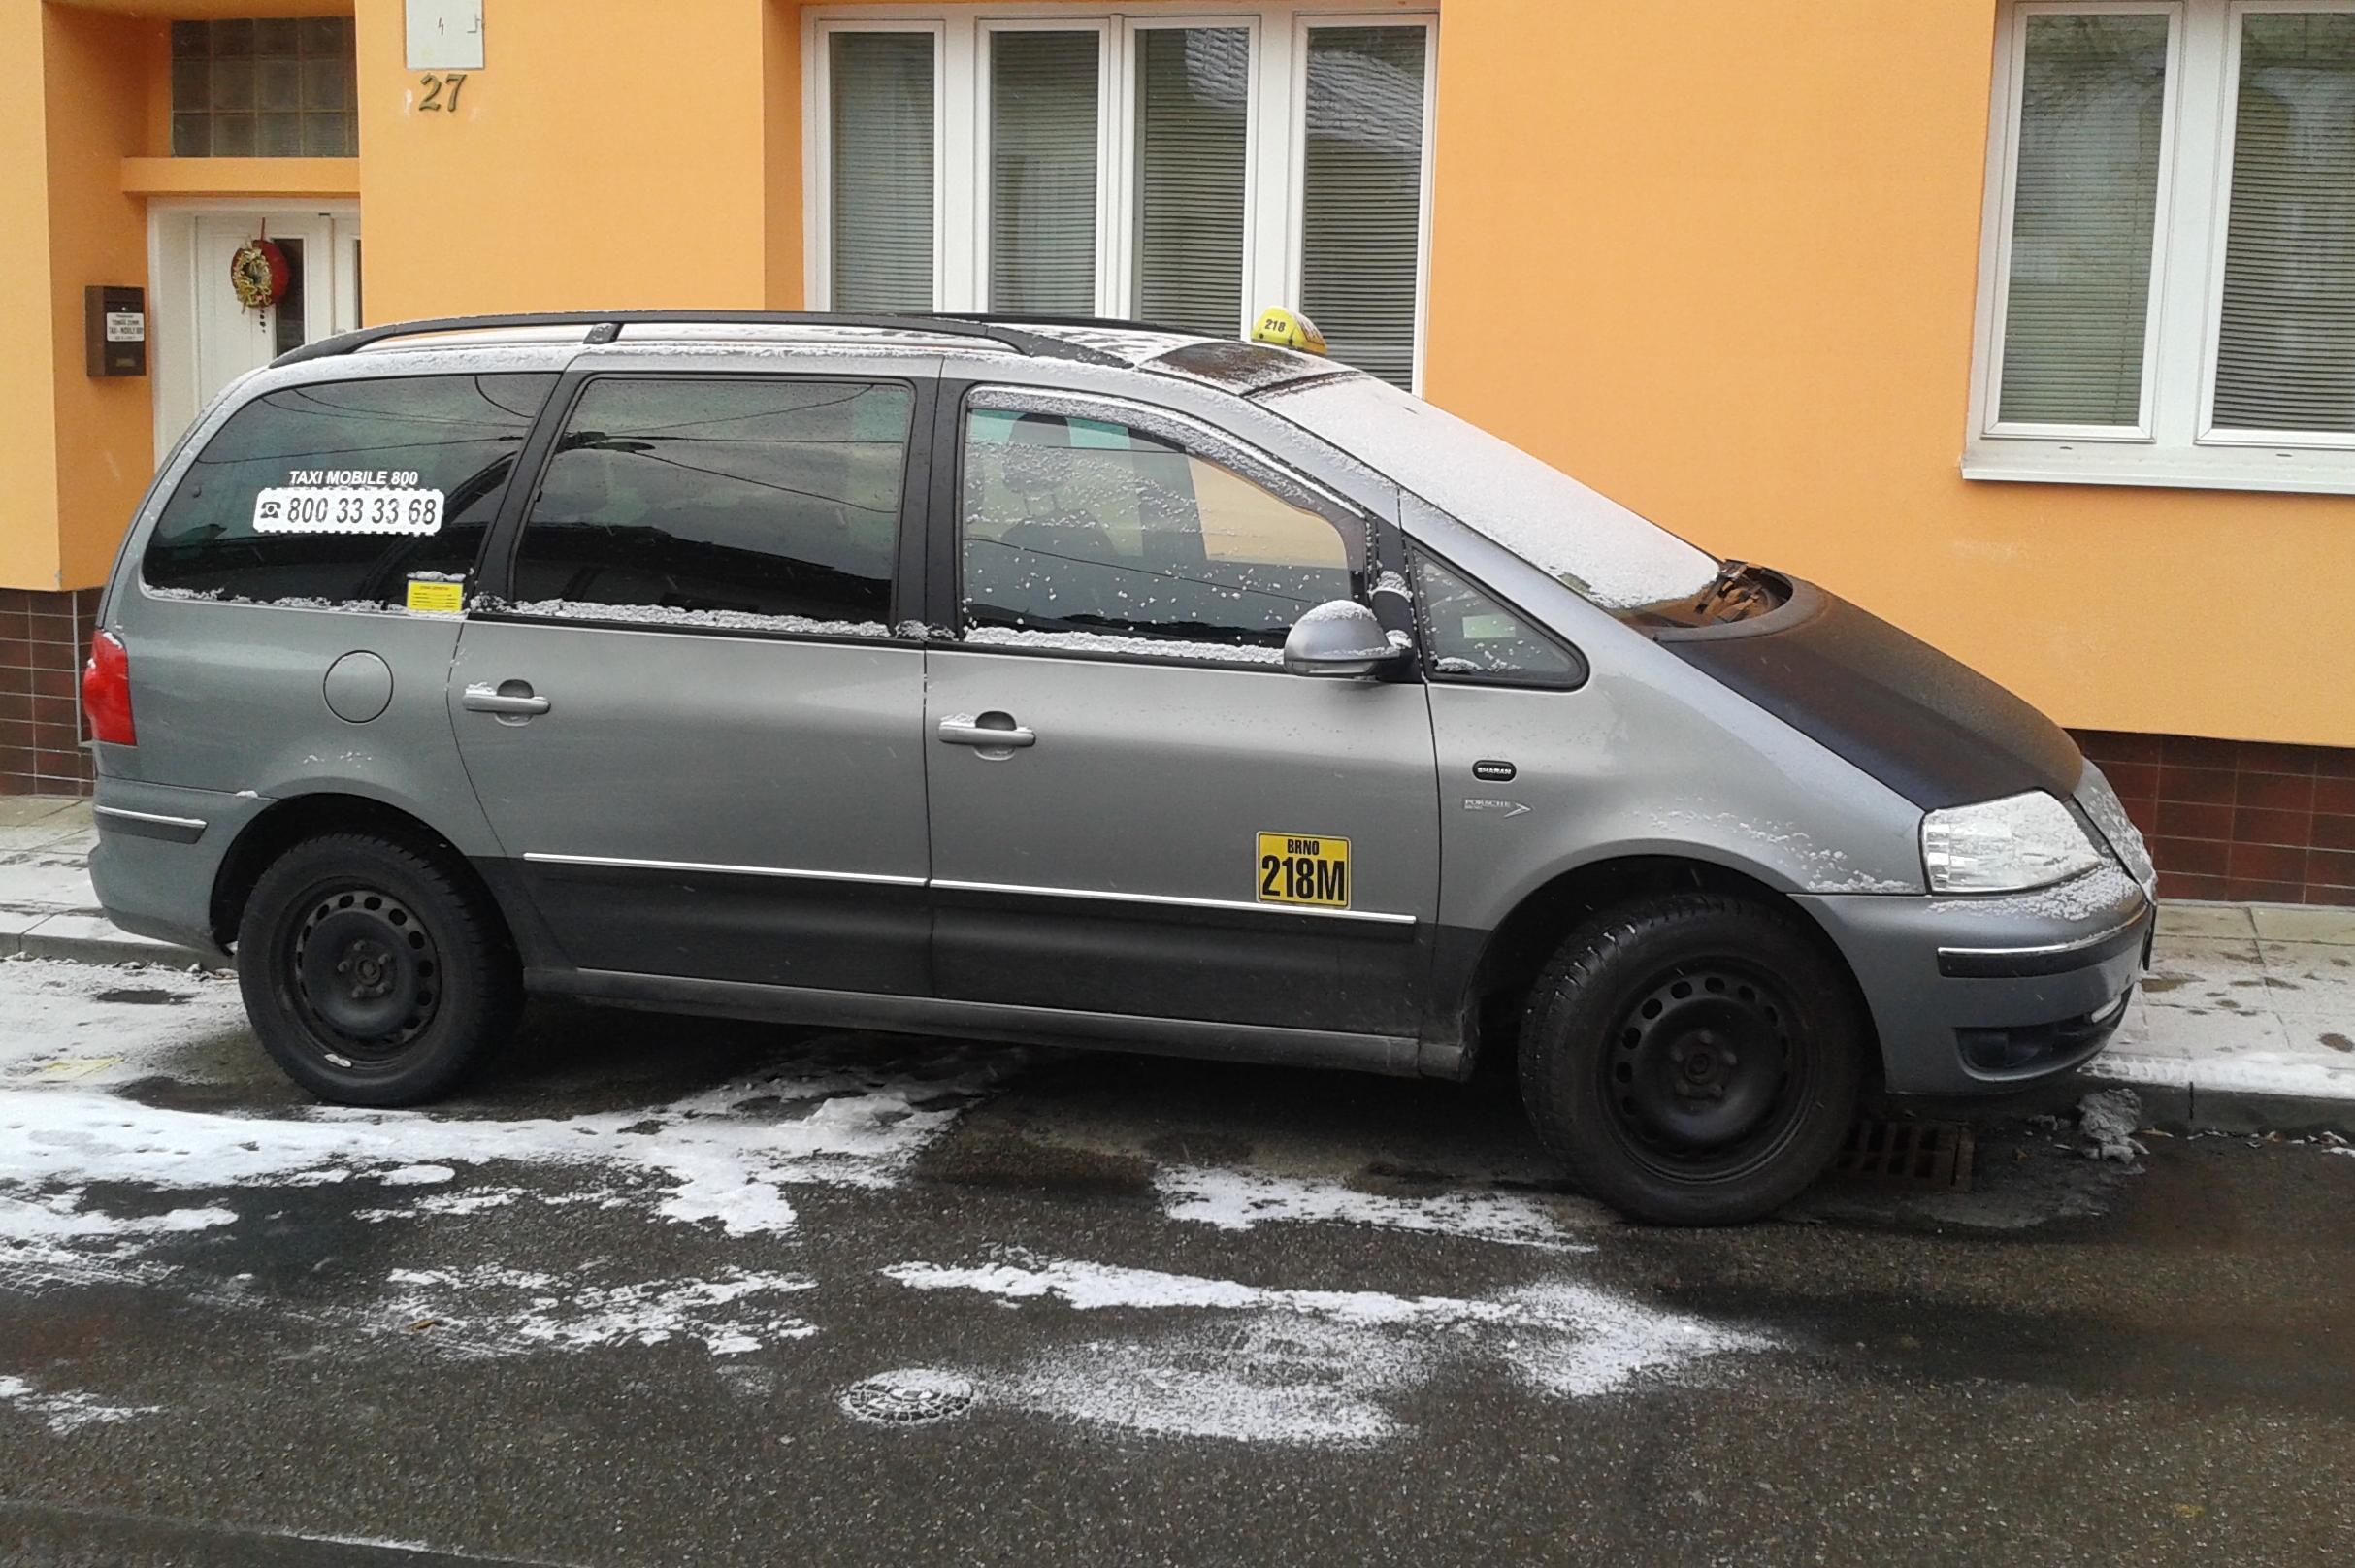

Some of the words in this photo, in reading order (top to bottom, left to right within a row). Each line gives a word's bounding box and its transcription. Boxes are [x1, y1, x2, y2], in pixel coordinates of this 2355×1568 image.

[418, 73, 468, 112] 27
[1264, 318, 1287, 333] 218
[289, 471, 323, 485] TAXI
[326, 471, 388, 485] MOBILE
[391, 471, 418, 485] 800
[287, 497, 329, 523] 800
[336, 497, 364, 524] 33
[372, 497, 399, 524] 33
[408, 498, 437, 525] 68
[1287, 838, 1320, 856] BRNO
[1261, 854, 1345, 901] 218M
